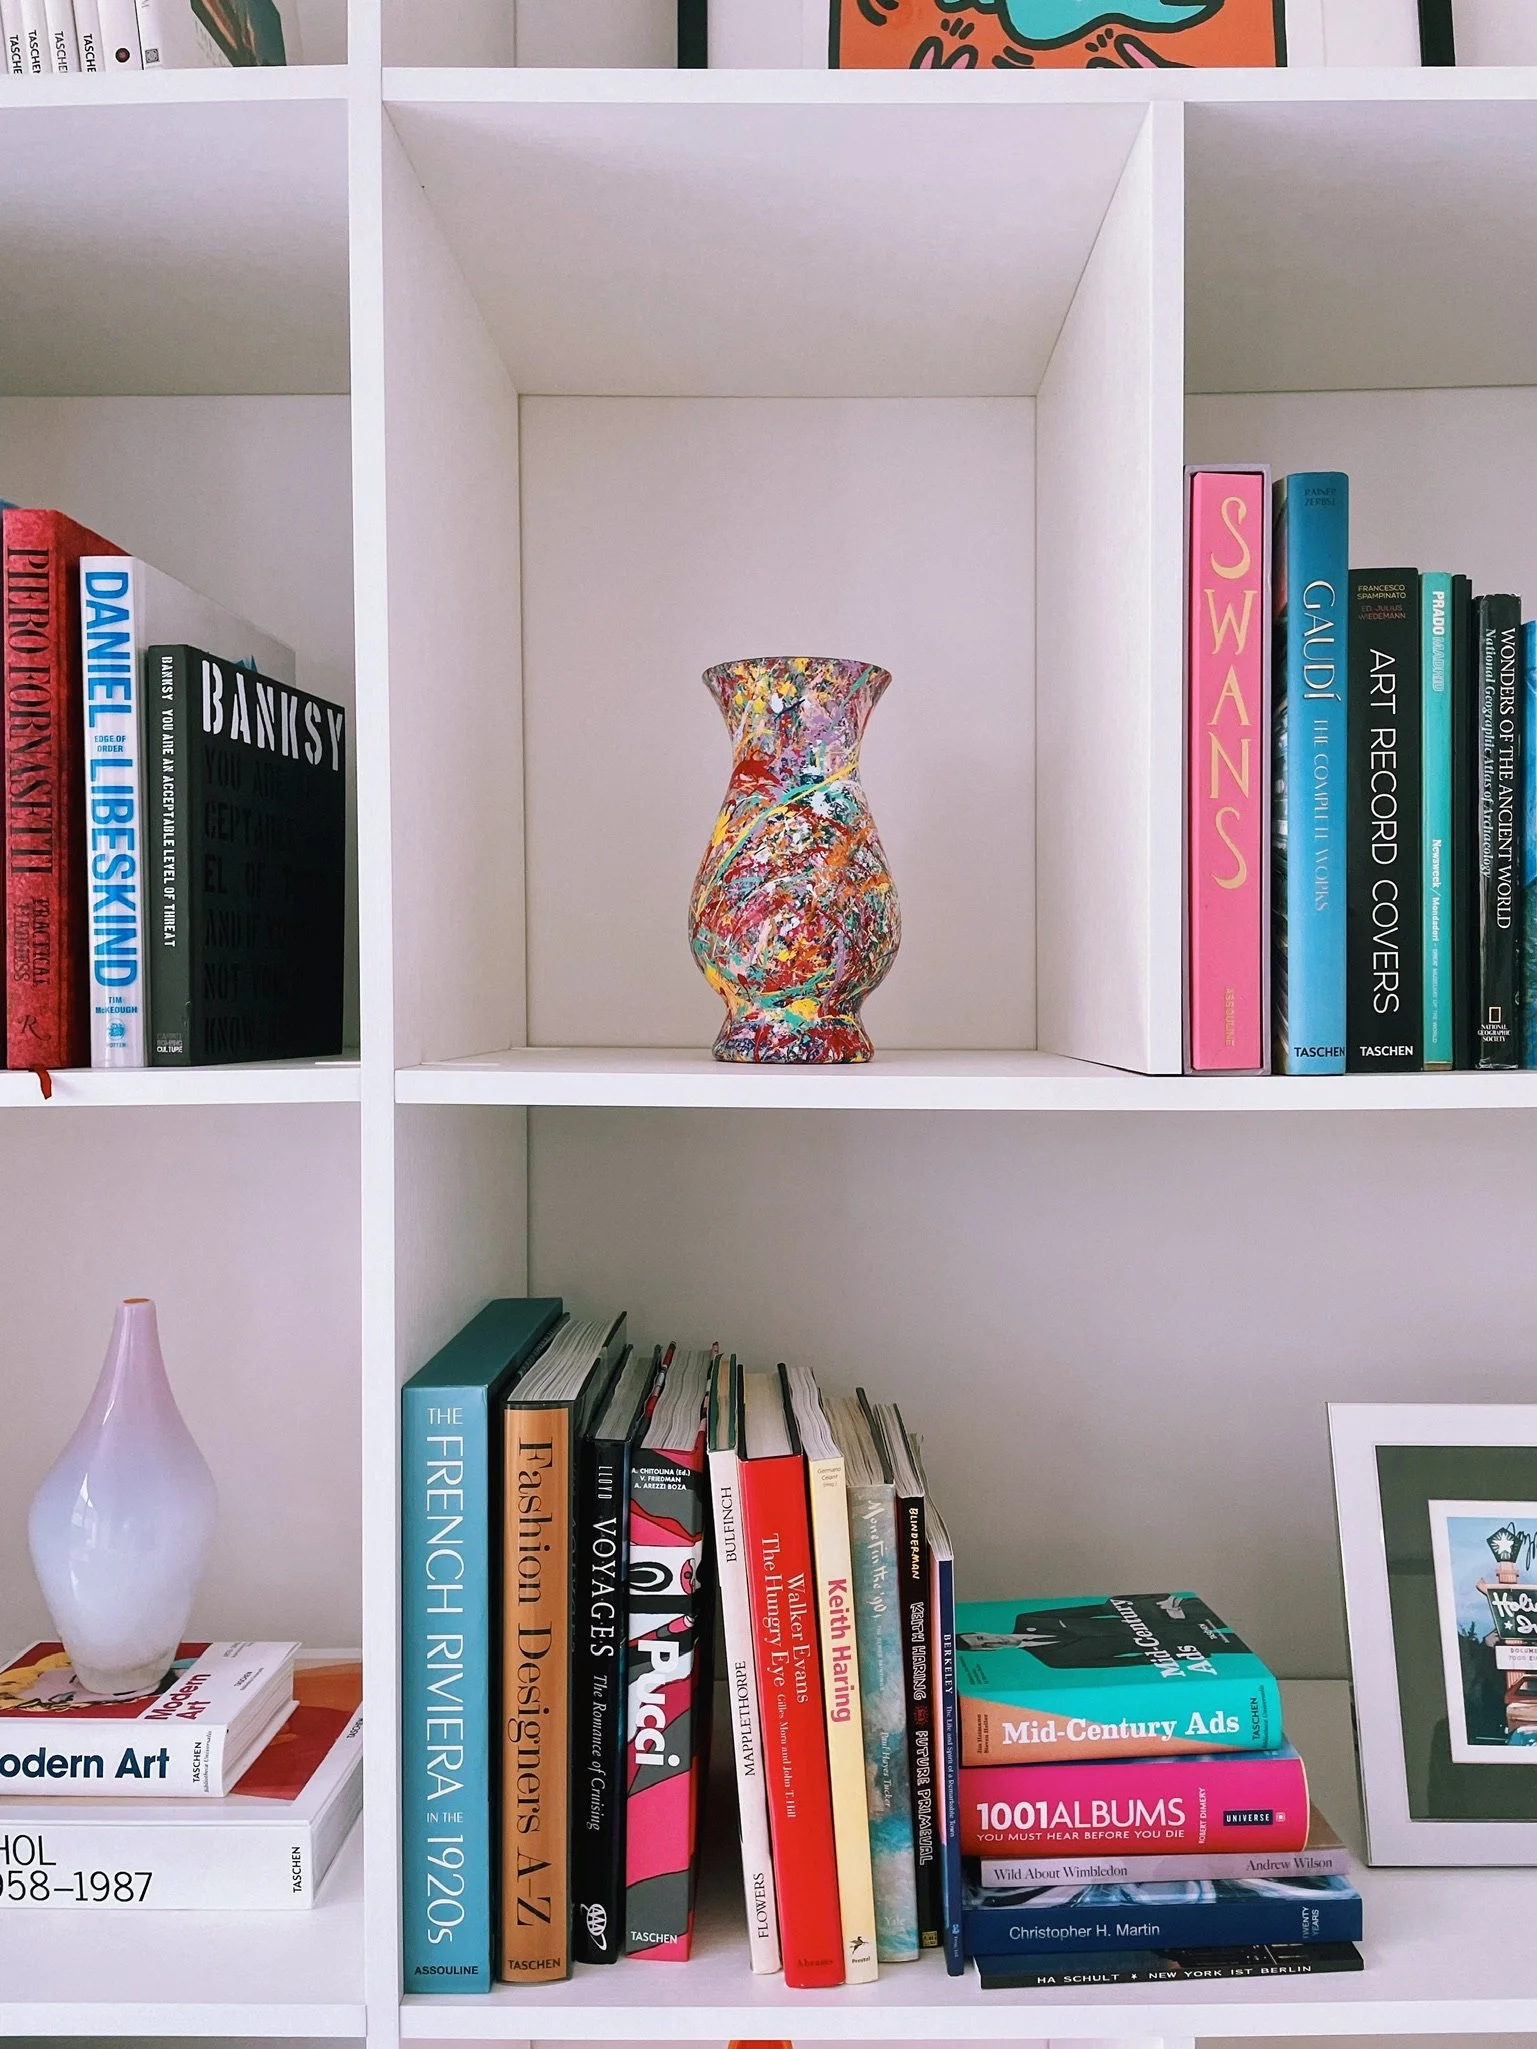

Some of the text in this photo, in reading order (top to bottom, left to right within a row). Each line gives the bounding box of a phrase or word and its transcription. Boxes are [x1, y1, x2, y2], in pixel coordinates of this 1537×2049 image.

[28, 29, 41, 74] TASCHE
[54, 31, 68, 73] TASCHE
[1357, 592, 1406, 600] SPAMPINATO
[1358, 584, 1406, 592] FRANCESCO
[1358, 612, 1406, 620] WIEDEMANN
[86, 572, 132, 728] DANIEL
[1432, 590, 1445, 692] PRADO MADRID
[1204, 496, 1258, 889] SWANS
[8, 547, 53, 877] PIERO FORNASETTI
[202, 660, 343, 771] BANKSY
[95, 735, 126, 743] EDGE OF
[1303, 580, 1341, 911] GAUDÍ THE COMPLETE WORKS
[1480, 628, 1497, 878] National Geographic Atlas of Archaeology
[1496, 628, 1516, 929] WONDERS OF THE ANCIENT WORLD
[161, 656, 176, 948] BANKSY YOU ARE AN ACCEPTABLE LEVEL OF THREAT
[1369, 648, 1399, 1014] ART RECORD COVERS
[90, 759, 138, 987] LIBESKIND
[1431, 839, 1442, 942] Newsweek Mondadori
[32, 897, 49, 988] PRACTICAL
[95, 1006, 138, 1014] McKEOUGH
[1225, 988, 1234, 1046] ASSOULINE
[1294, 1047, 1345, 1058] TASCHEN
[1360, 1045, 1414, 1057] TASCHEN
[427, 1407, 464, 1425] THE
[598, 1466, 613, 1499] LLOYD
[676, 1469, 690, 1477] (Ed.)
[518, 1436, 553, 1606] Fashion
[721, 1486, 737, 1563] BULFINCH
[862, 1500, 886, 1550] Monet
[762, 1533, 780, 1571] The
[873, 1565, 889, 1589] the
[426, 1436, 464, 1801] FRENCH RIVIERA
[762, 1575, 783, 1647] Hungry
[787, 1572, 810, 1703] Walker Evans
[828, 1578, 854, 1723] Keith Haring
[1111, 1598, 1186, 1678] Mid-Century
[767, 1651, 790, 1687] Eye
[943, 1634, 953, 1694] BERKELEY
[1177, 1645, 1217, 1675] Ads
[144, 1673, 211, 1720] Modern
[593, 1675, 608, 1698] The
[635, 1639, 681, 1767] Pucci
[909, 1507, 933, 1866] BLINDERMAN KEITH HARING FUTURE PRIMEVAL
[175, 1700, 211, 1720] Art
[735, 1661, 755, 1776] MAPPLETHORPE
[776, 1694, 787, 1719] Gilles
[1250, 1697, 1259, 1741] TASCHEN
[508, 1622, 552, 1834] Designers
[592, 1702, 607, 1756] Romance
[946, 1733, 954, 1745] and
[1002, 1718, 1177, 1746] Mid-Century
[1185, 1711, 1240, 1735] Ads
[115, 1748, 170, 1779] Art
[192, 1742, 202, 1783] TASCHEN
[587, 1761, 605, 1776] of
[781, 1747, 790, 1764] and
[782, 1765, 793, 1788] John
[881, 1753, 894, 1808] Hayes Tucker
[427, 1812, 464, 1823] IN THE
[586, 1777, 606, 1830] Cruising
[786, 1800, 797, 1818] Hill
[1226, 1812, 1270, 1823] UNIVERSE
[977, 1829, 1185, 1841] YOU MUST HEAR BEFORE YOU DIE
[1198, 1815, 1206, 1844] ROBERT
[292, 1846, 301, 1893] TASCHEN
[993, 1865, 1128, 1881] Wild About Wimbledon
[1246, 1857, 1333, 1872] Andrew Wilson
[0, 1870, 153, 1902] 58–1987
[427, 1834, 465, 1944] 1920s
[753, 1872, 769, 1938] FLOWERS
[587, 1904, 607, 1935] AAA
[631, 1931, 678, 1944] TASCHEN
[1009, 1922, 1160, 1941] Christopher H. Martin
[1302, 1906, 1310, 1939] TWENTY
[1312, 1909, 1320, 1936] YEARS
[414, 1966, 478, 1975] ASSOULINE
[508, 1958, 560, 1970] TASCHEN
[1037, 1965, 1312, 1985] HA SCHULT NEW YORK IST BERLIN
